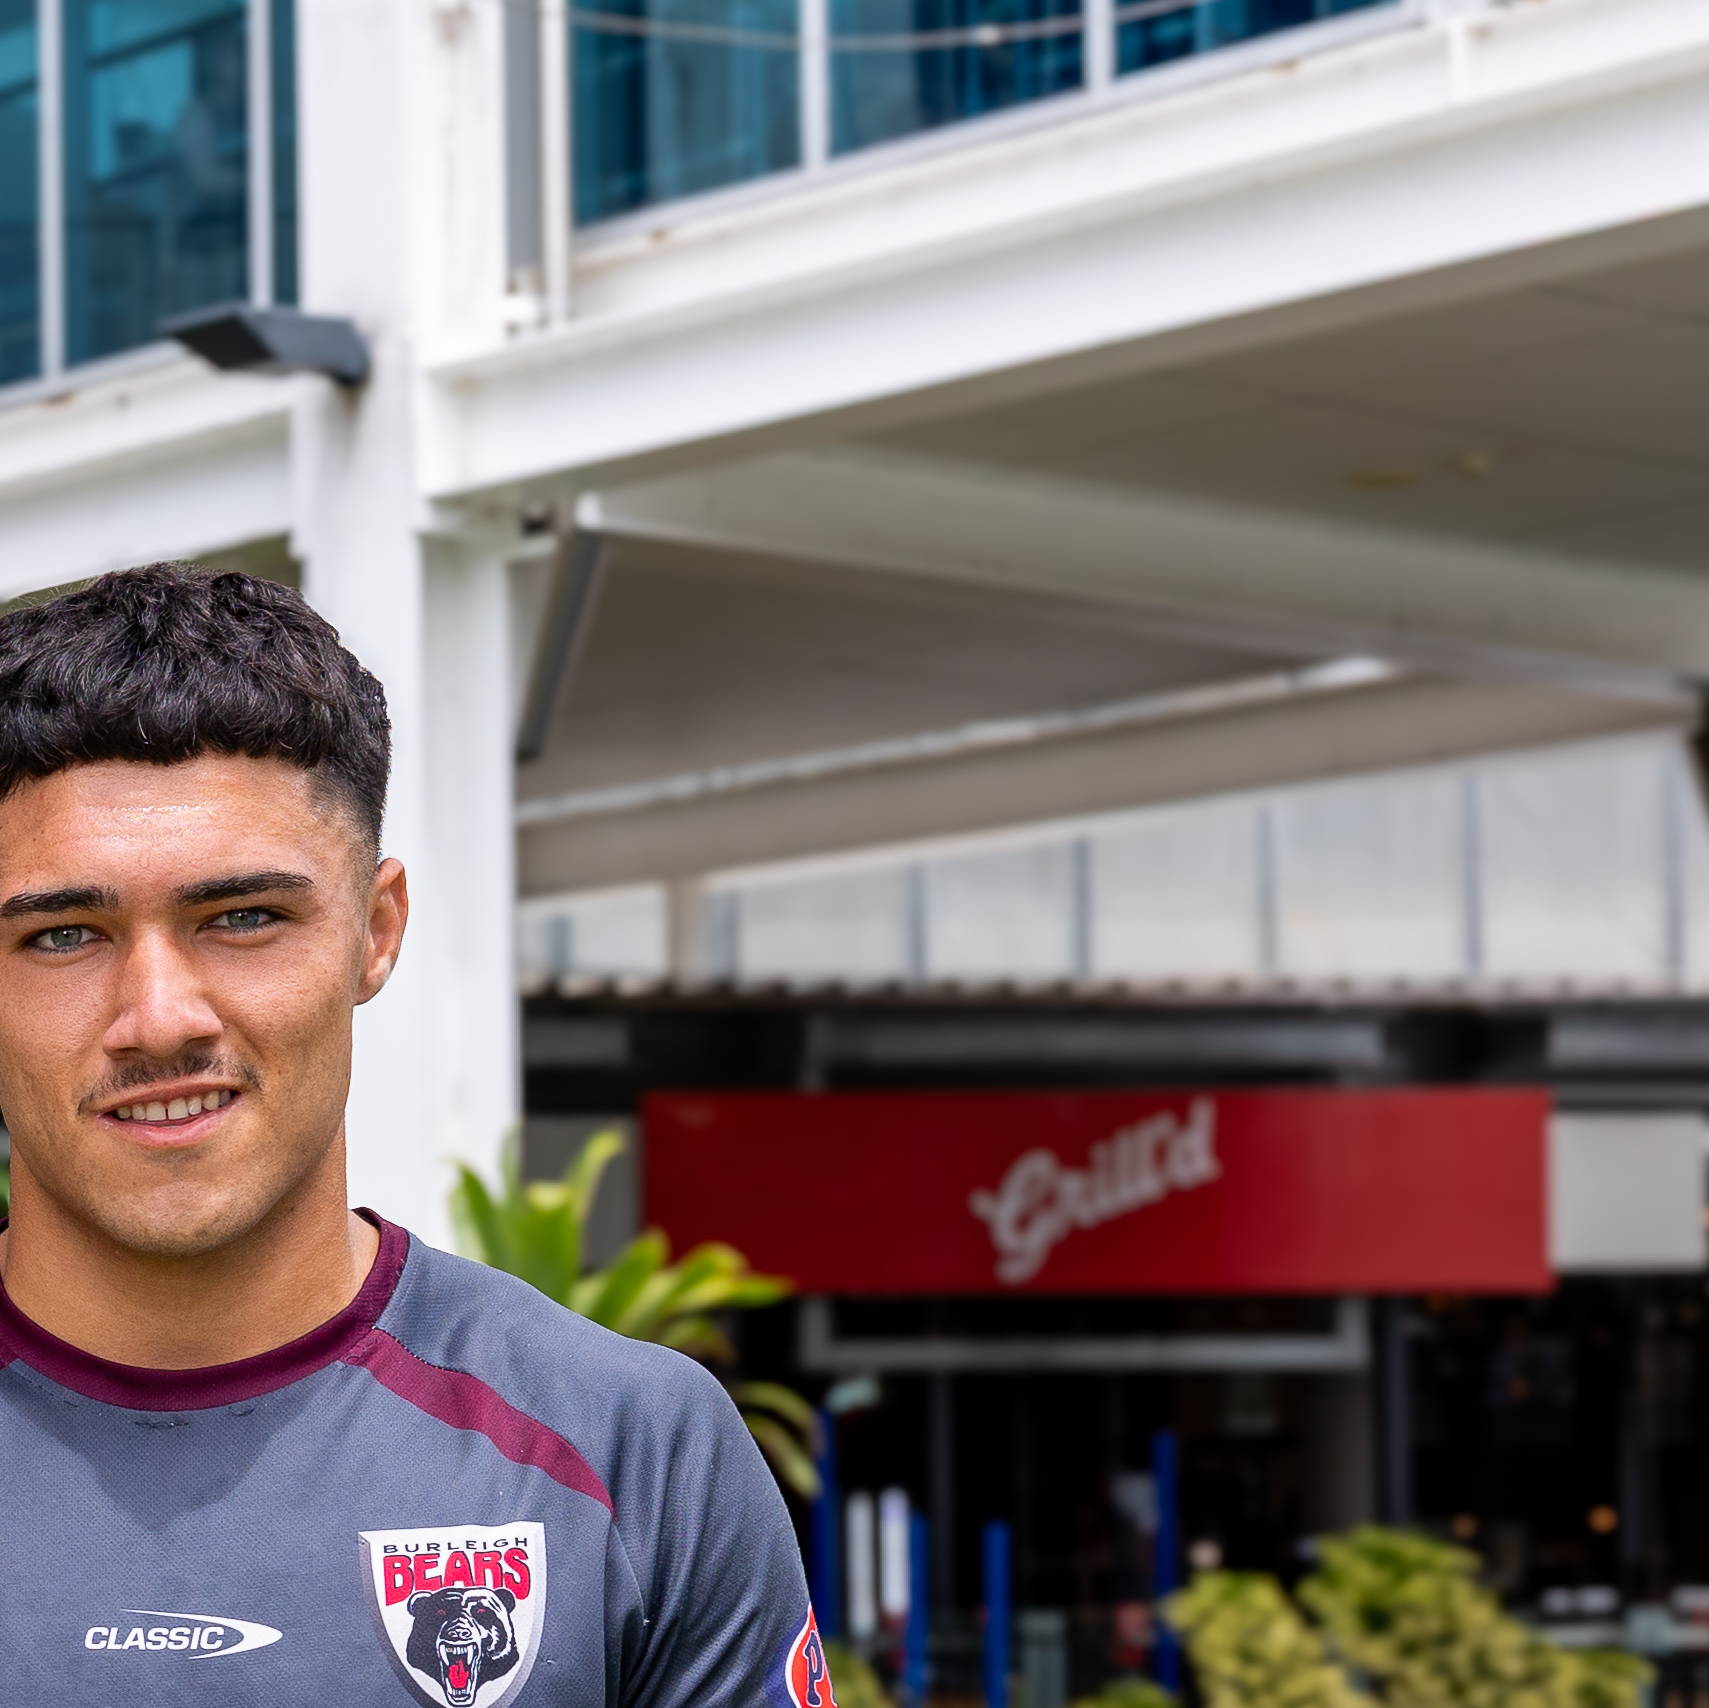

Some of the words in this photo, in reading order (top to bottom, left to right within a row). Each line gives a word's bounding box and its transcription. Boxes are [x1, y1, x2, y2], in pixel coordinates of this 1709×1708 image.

[969, 1094, 1223, 1285] Grill'd
[383, 1537, 528, 1553] BURLEIGH
[383, 1547, 531, 1607] BEARS
[84, 1626, 224, 1651] CLASSIC
